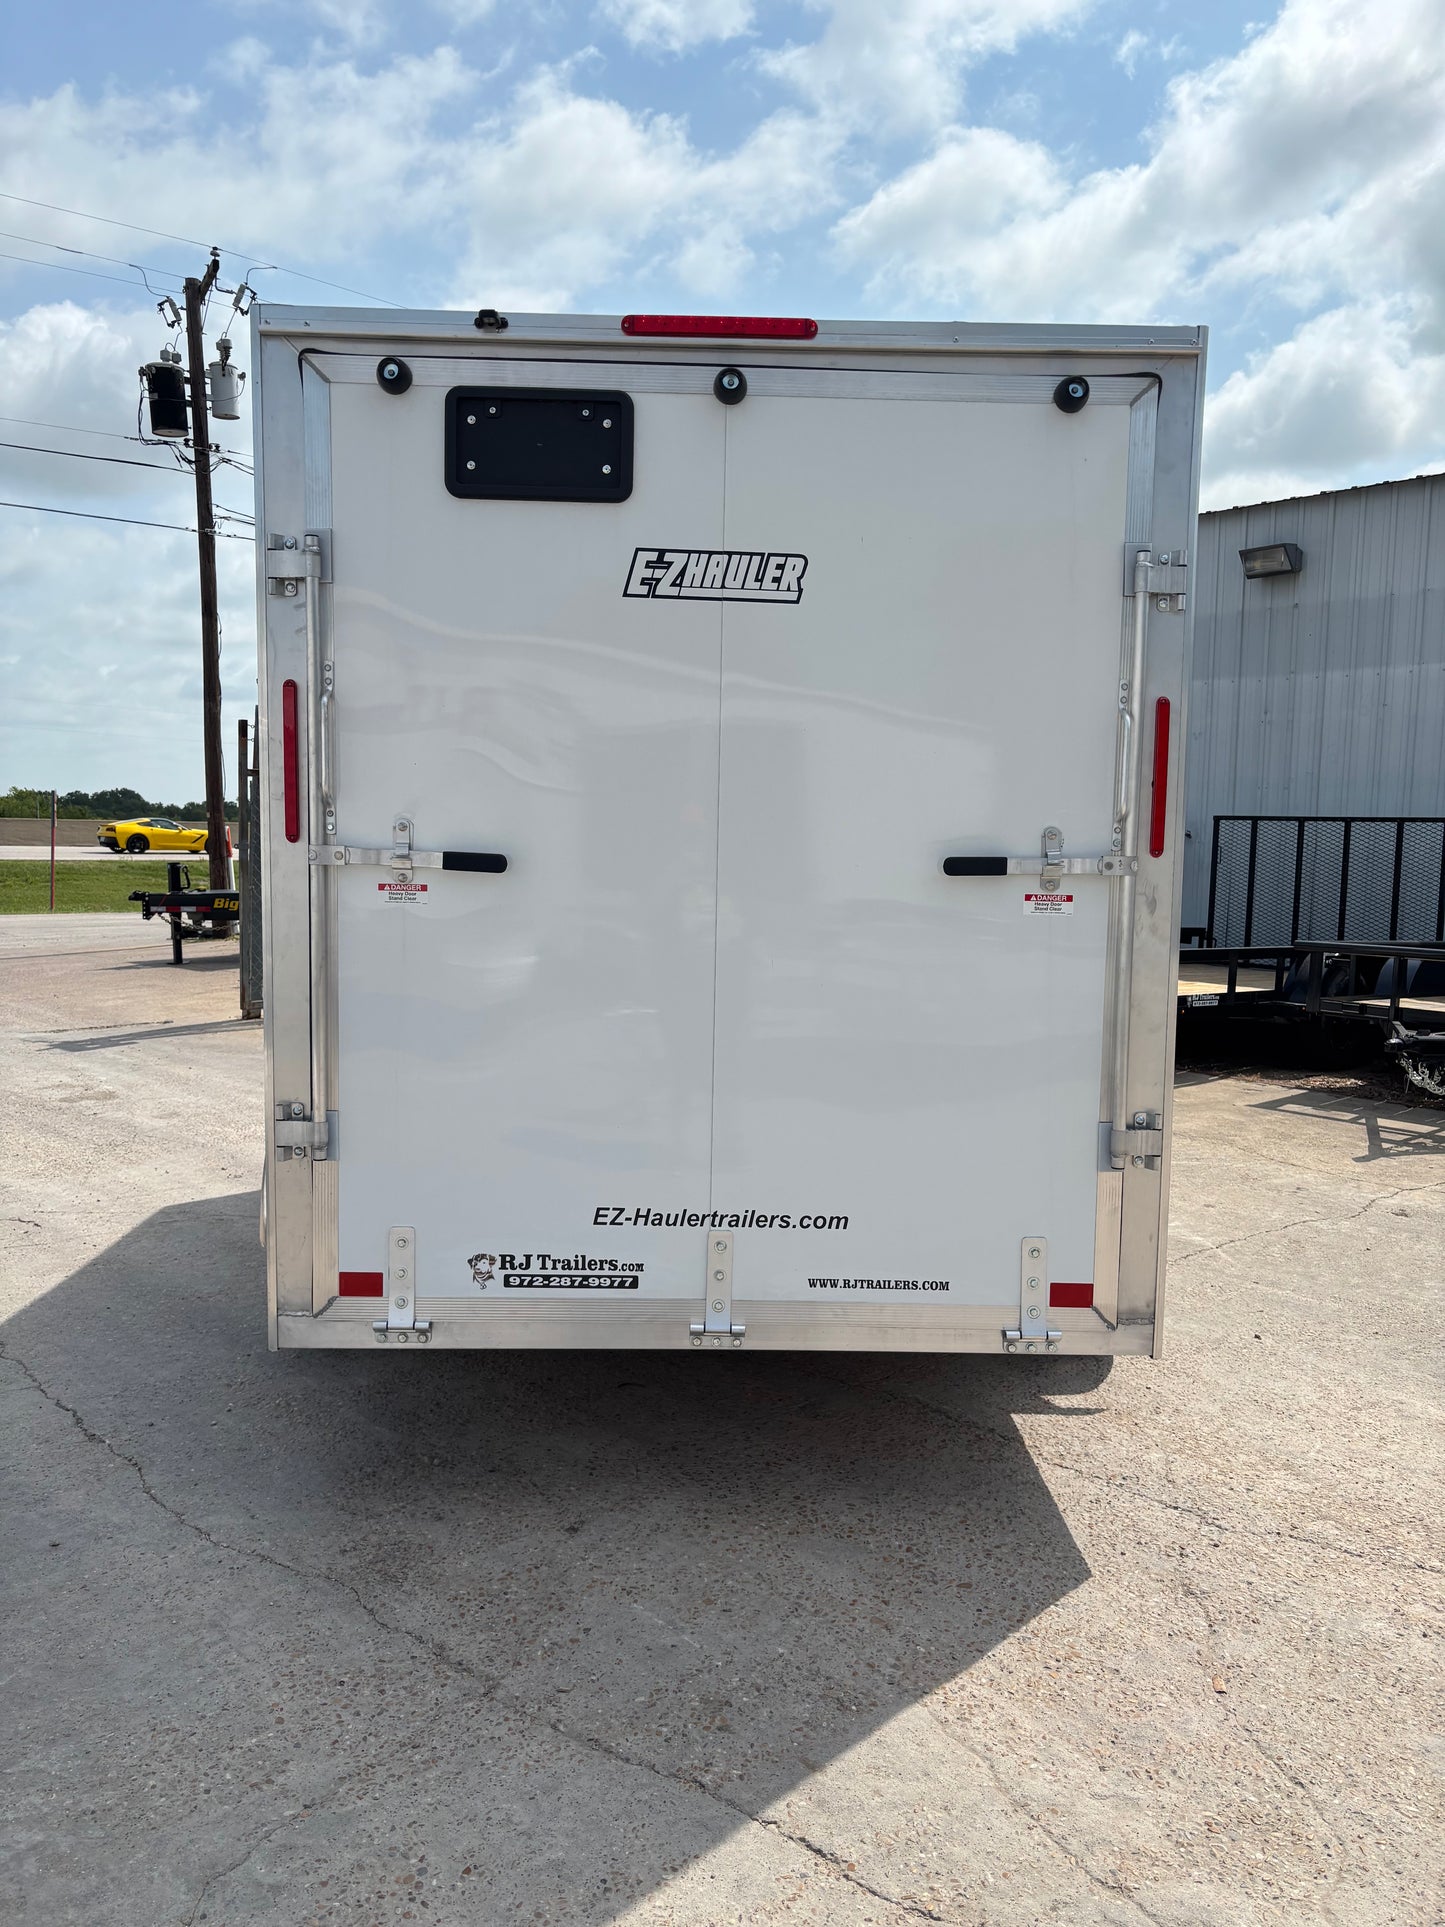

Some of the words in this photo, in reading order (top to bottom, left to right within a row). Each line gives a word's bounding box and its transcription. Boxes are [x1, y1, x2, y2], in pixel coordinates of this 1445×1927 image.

[213, 898, 239, 911] Big
[593, 1207, 849, 1230] EZ-Haulertrailers.com
[499, 1254, 533, 1271] RJ
[509, 1276, 633, 1287] 972-287-9977
[808, 1278, 950, 1291] WWW.RJTRAILERS.COM
